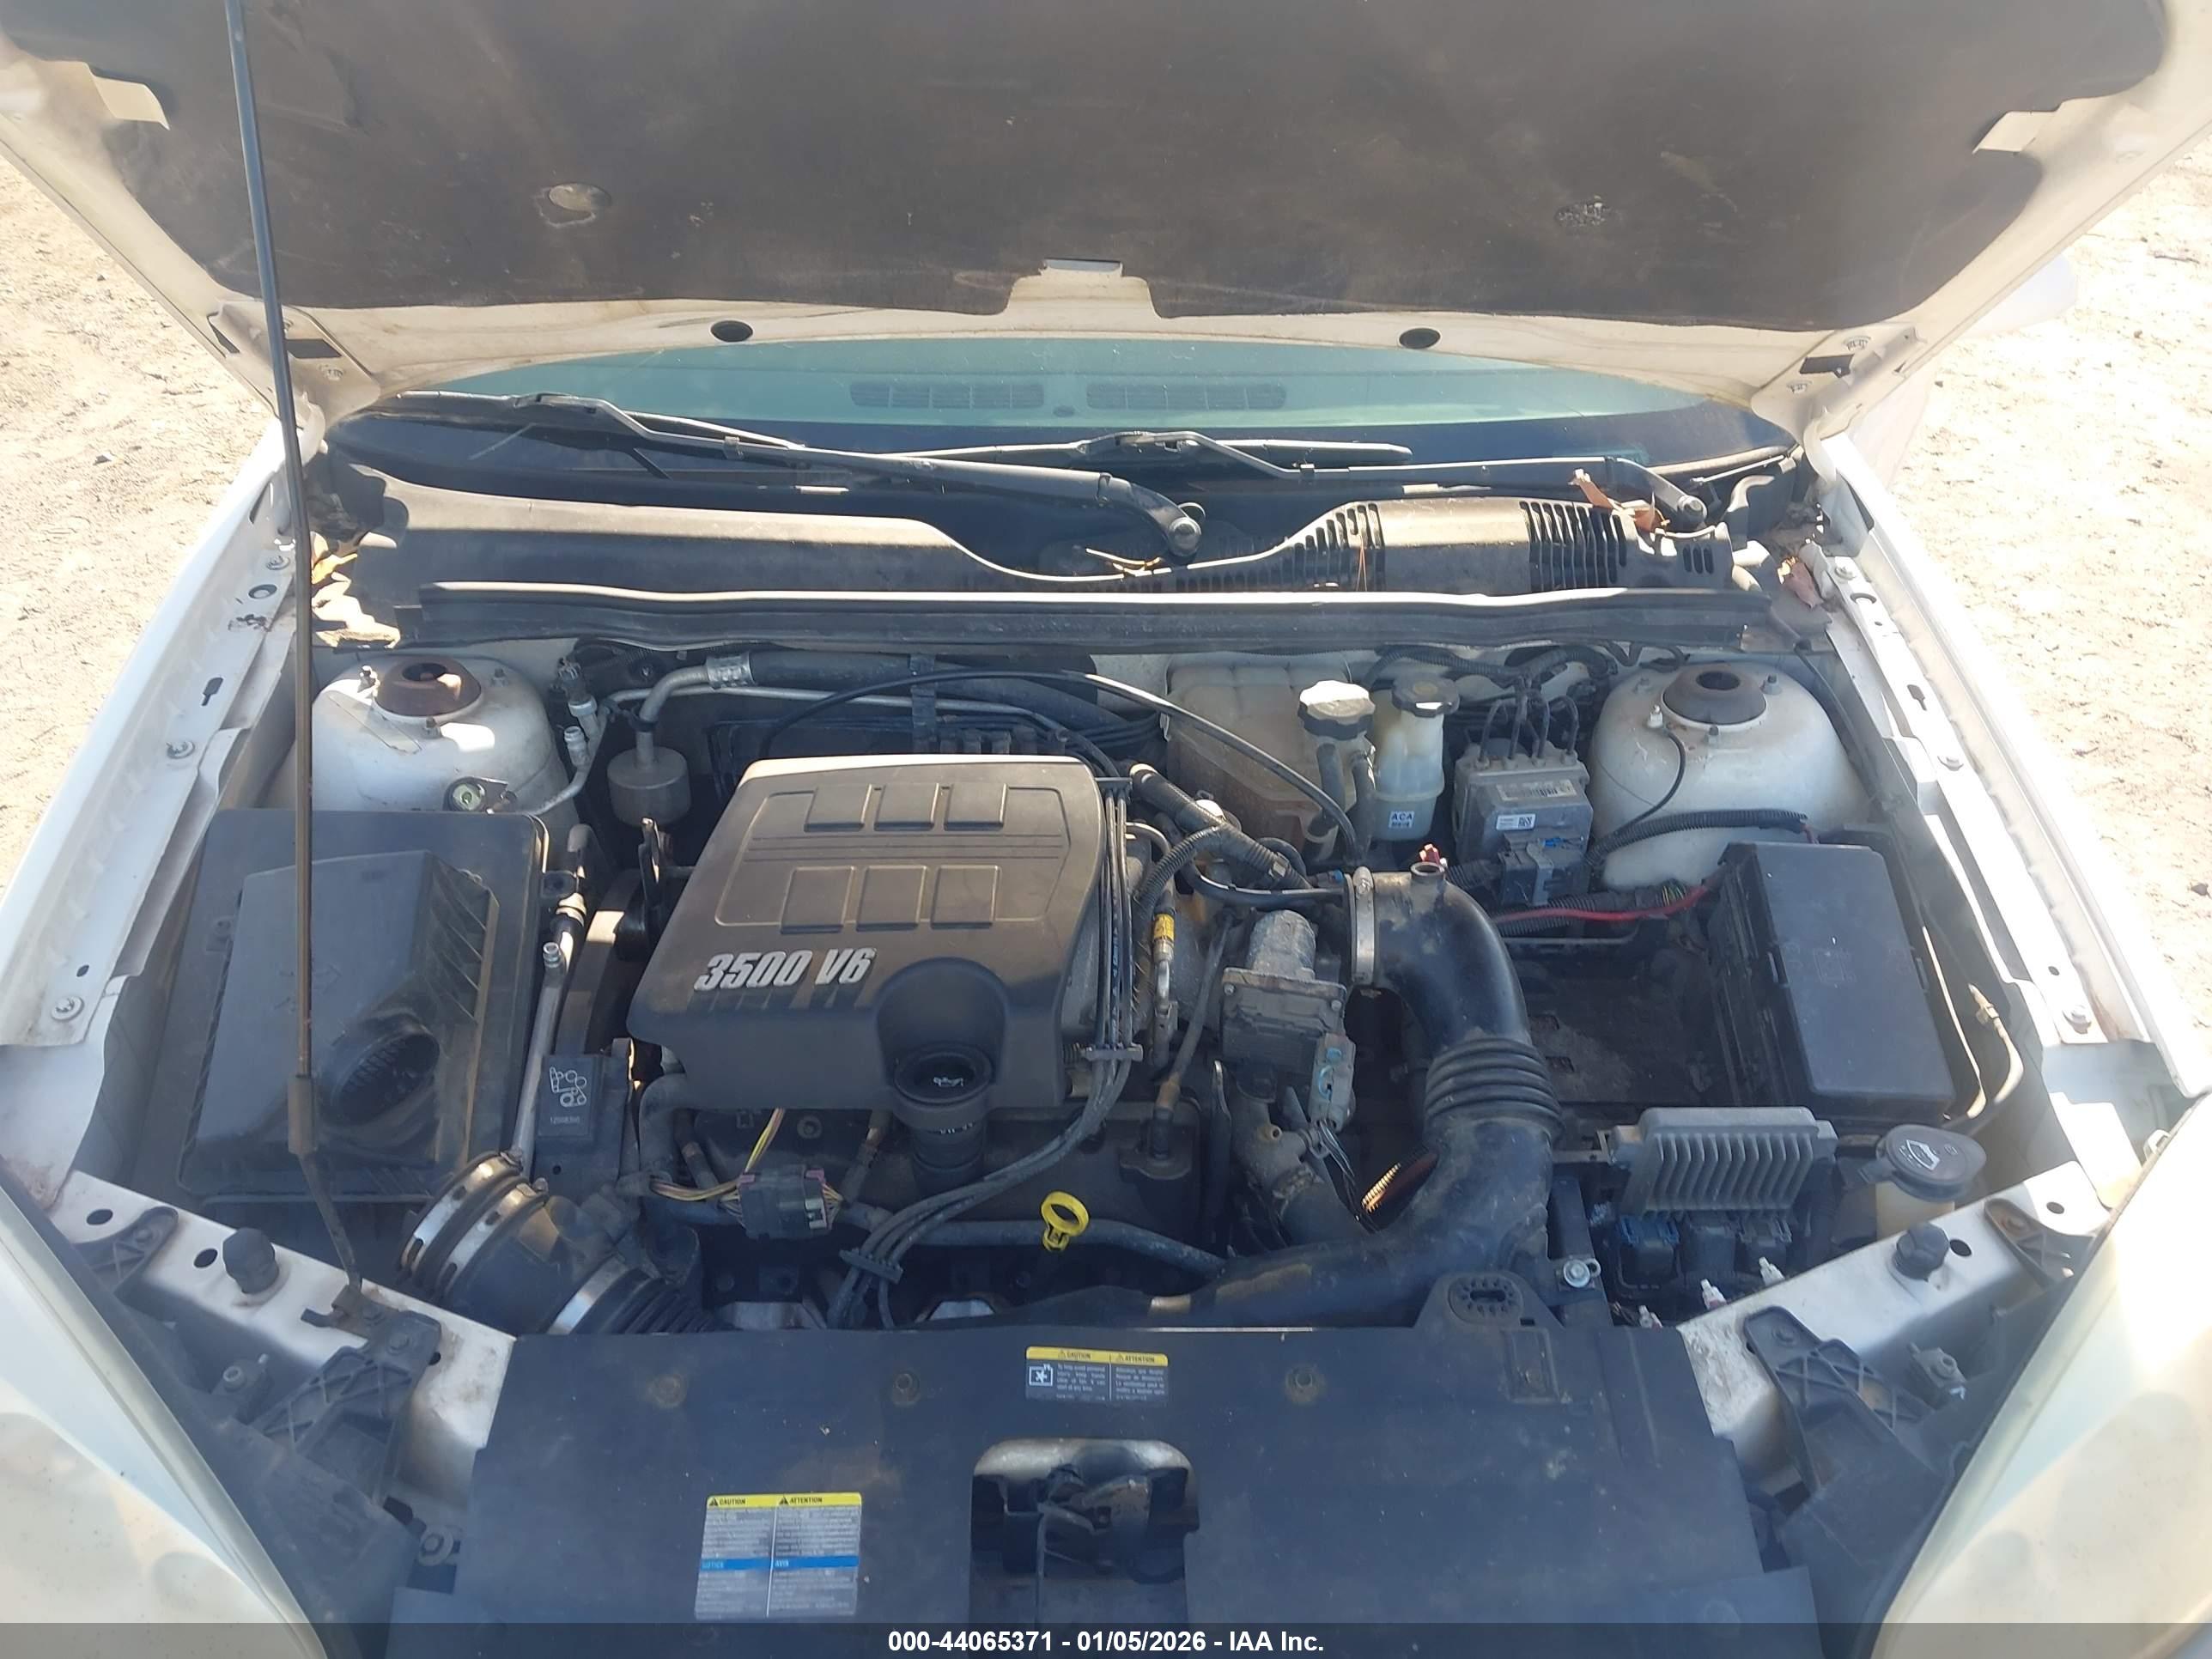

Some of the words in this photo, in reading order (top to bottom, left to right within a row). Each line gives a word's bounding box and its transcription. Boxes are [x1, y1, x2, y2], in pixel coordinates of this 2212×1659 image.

[694, 950, 813, 991] 3500
[815, 947, 878, 985] V6
[1066, 1351, 1091, 1359] CAUTION
